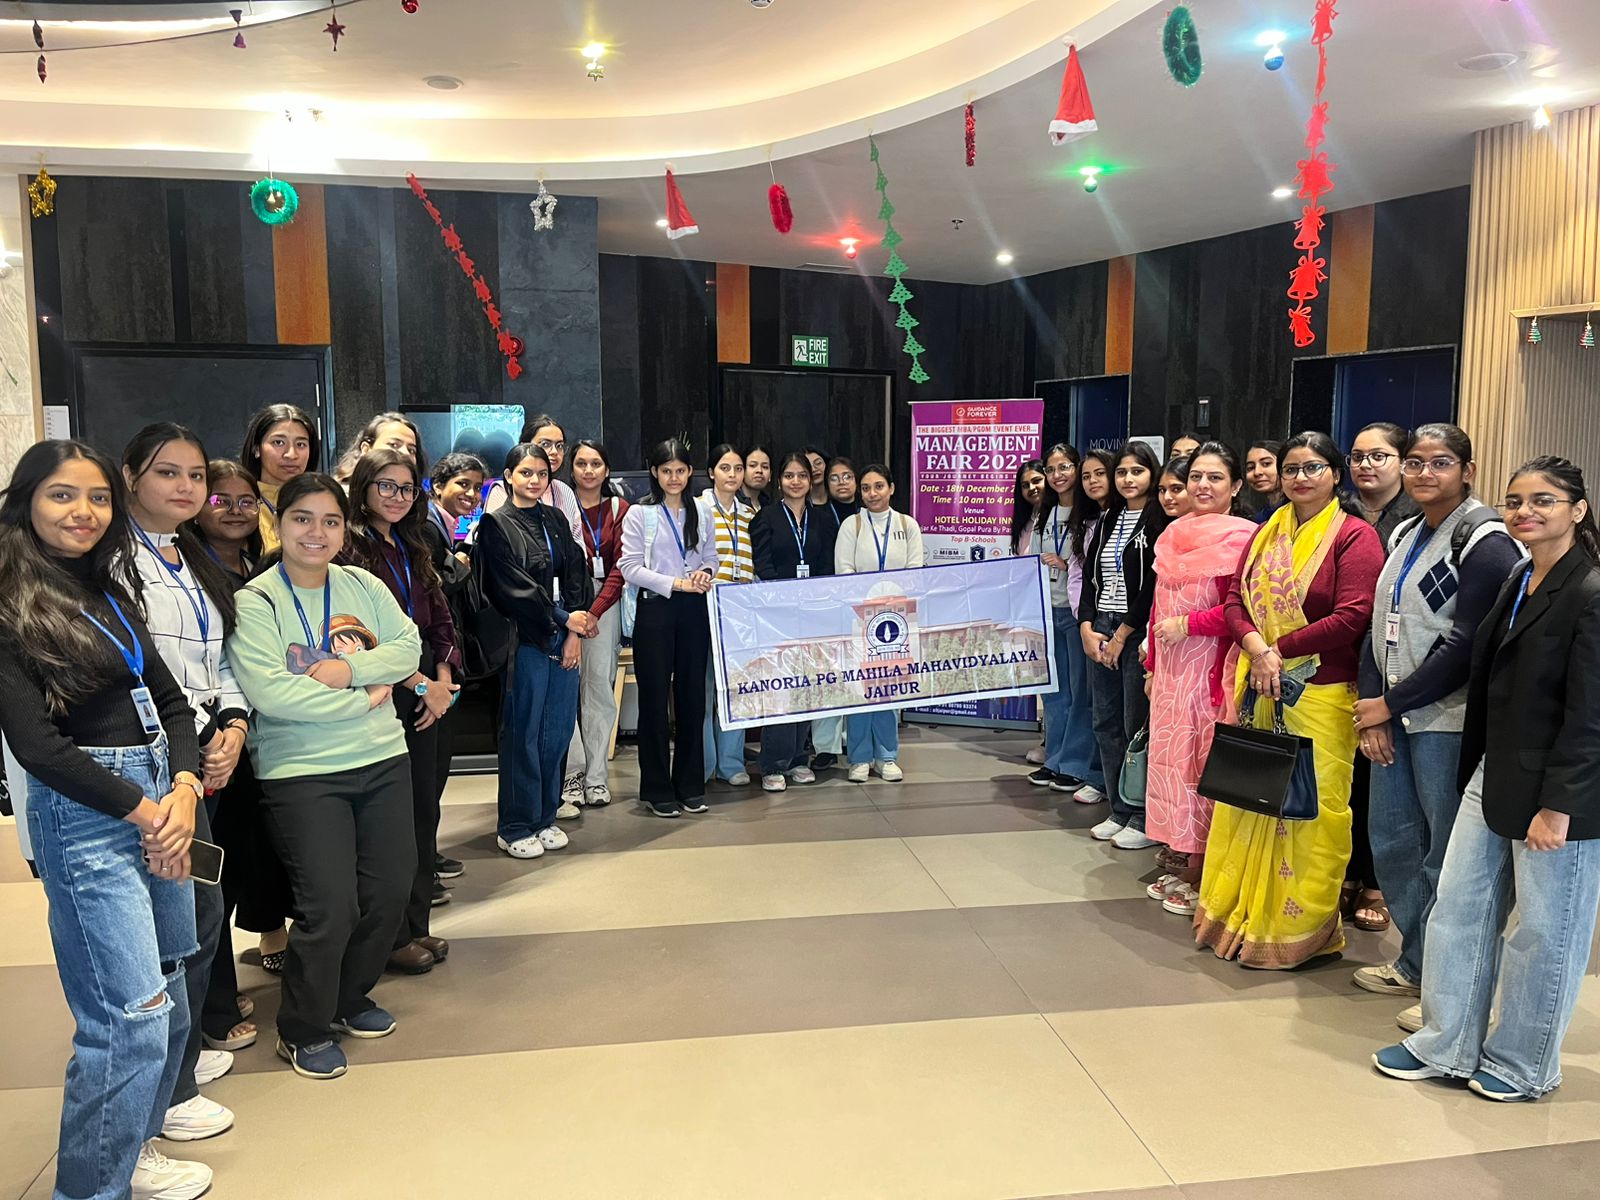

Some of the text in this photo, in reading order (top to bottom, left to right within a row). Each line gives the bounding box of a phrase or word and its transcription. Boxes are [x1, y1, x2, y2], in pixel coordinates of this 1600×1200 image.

[809, 338, 827, 351] FIRE
[809, 352, 827, 365] EXIT
[918, 426, 929, 434] THE
[916, 435, 1040, 452] MANAGEMENT
[926, 454, 973, 470] FAIR
[920, 484, 939, 493] Date
[946, 484, 965, 493] 18th
[966, 484, 1009, 493] December
[932, 495, 952, 504] Time
[959, 495, 969, 504] 10
[986, 496, 995, 504] to
[996, 496, 1003, 504] 4
[934, 516, 960, 524] HOTEL
[962, 516, 997, 524] HOLIDAY
[958, 525, 976, 534] Gopal
[993, 526, 1001, 534] By
[951, 535, 963, 543] Top
[737, 649, 1039, 695] KANORIA PG MAHILA MAHAVIDYALAYA
[864, 681, 921, 699] JAIPUR
